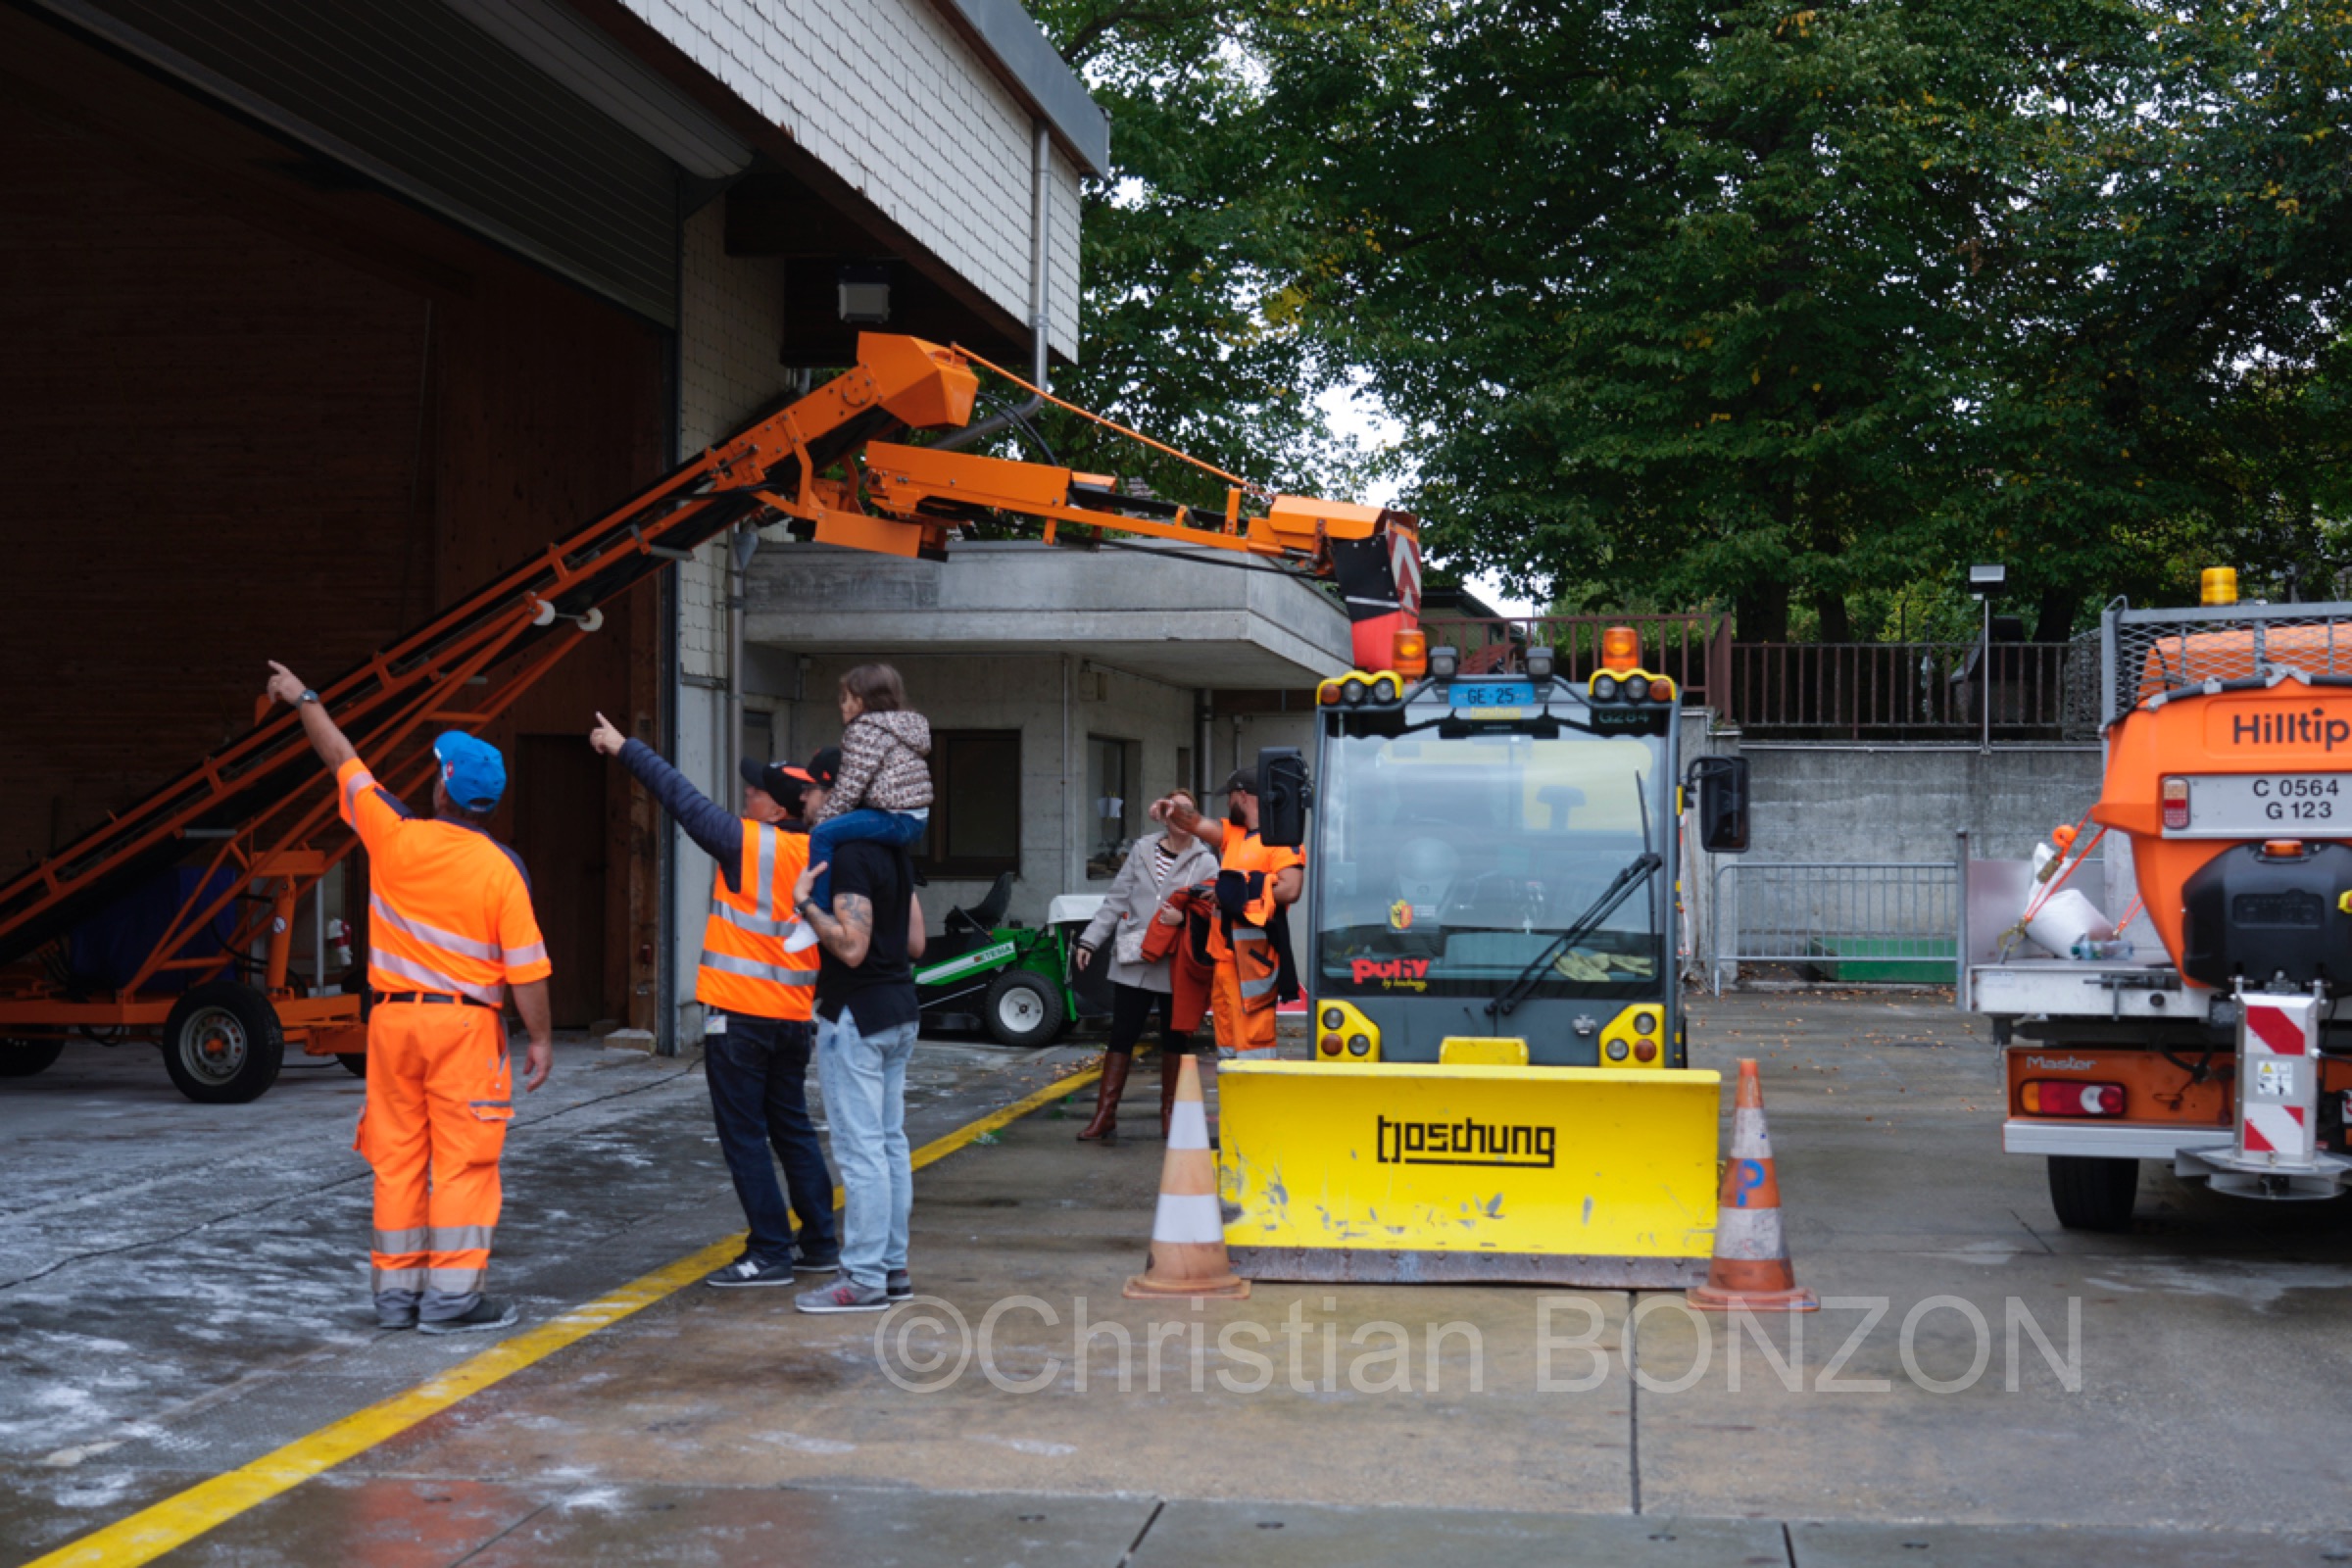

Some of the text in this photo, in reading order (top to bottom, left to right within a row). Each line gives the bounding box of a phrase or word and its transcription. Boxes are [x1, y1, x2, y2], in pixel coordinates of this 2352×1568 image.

[1467, 687, 1515, 705] GE 25
[2232, 708, 2351, 753] Hilltip
[2252, 778, 2339, 798] C 0564
[2265, 801, 2333, 820] G 123
[2026, 1055, 2096, 1070] Master
[1377, 1115, 1555, 1168] boschung
[1737, 1158, 1765, 1206] P
